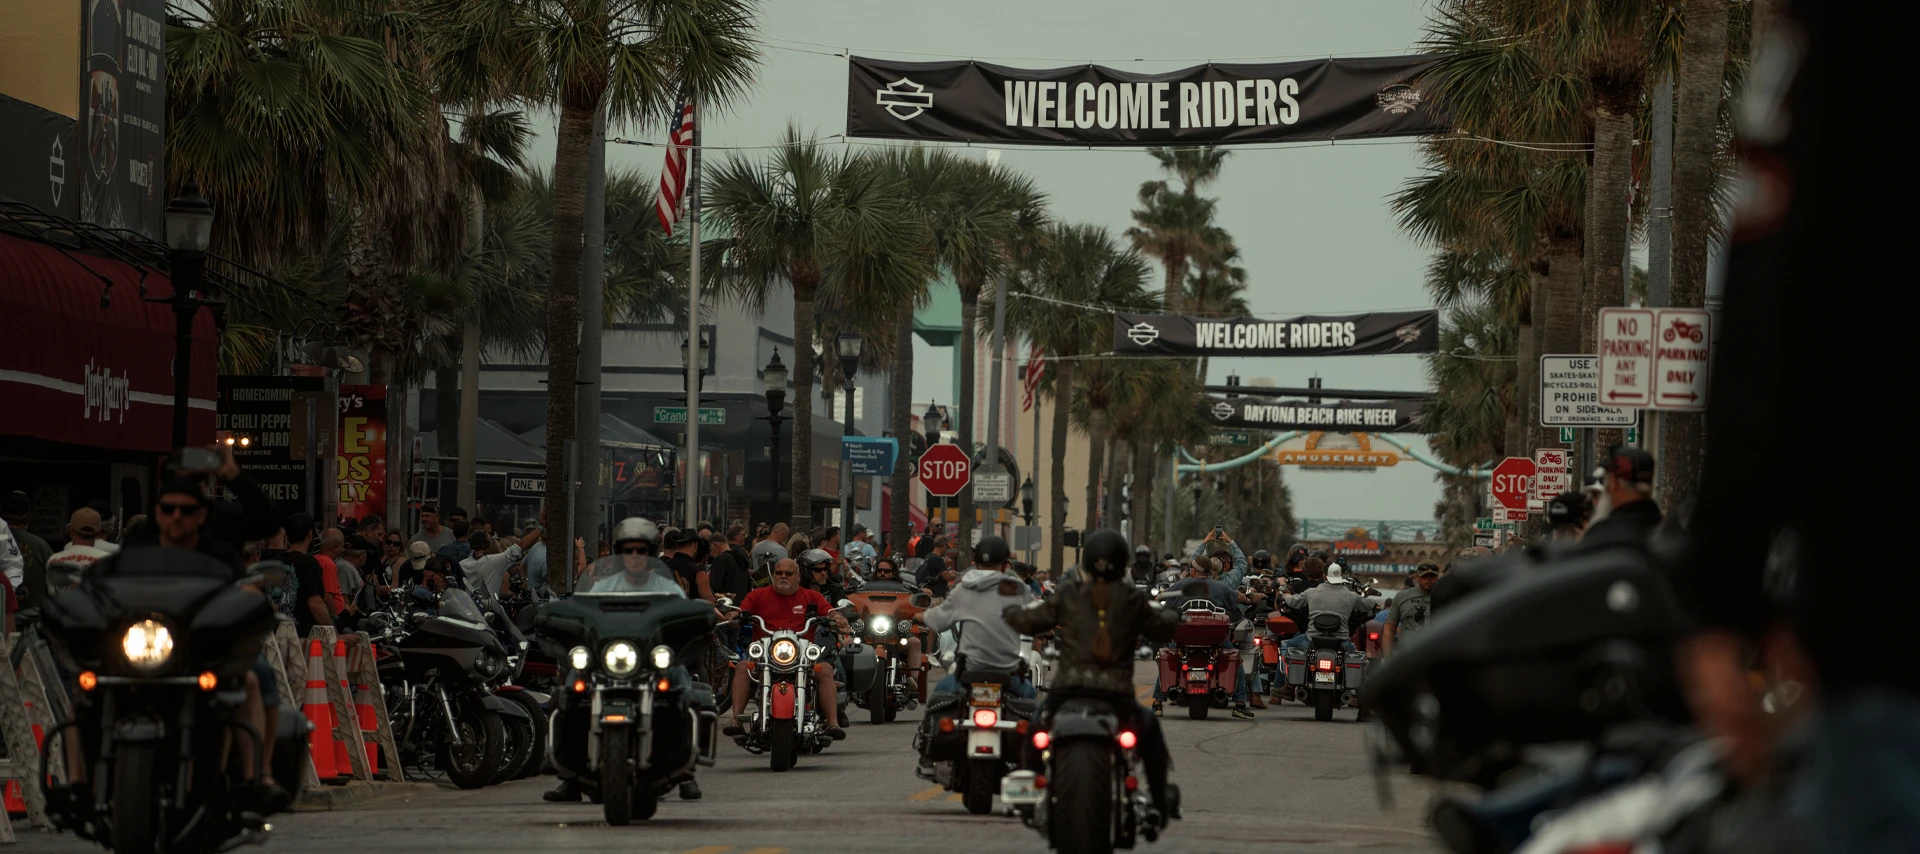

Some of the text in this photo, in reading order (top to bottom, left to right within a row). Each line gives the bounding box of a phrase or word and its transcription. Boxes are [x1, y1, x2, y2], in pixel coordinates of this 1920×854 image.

[1004, 78, 1300, 129] WELCOME RIDERS
[1617, 317, 1638, 337] NO
[1196, 322, 1356, 349] WELCOME RIDERS
[1603, 340, 1650, 358] PARKING
[1658, 348, 1708, 361] PARKING
[1569, 360, 1590, 369] USE
[1615, 361, 1636, 372] ANY
[1614, 373, 1637, 387] TIME
[1666, 370, 1696, 384] ONLY
[84, 357, 129, 424] Dirty Harry's
[1554, 393, 1598, 402] PROHIB
[216, 413, 291, 429] OT CHILI PEPPE
[1244, 404, 1397, 426] DAYTONA BEACH BIKE WEEK
[261, 431, 292, 447] HARD
[1209, 433, 1234, 444] antic
[1564, 428, 1573, 440] N
[1284, 454, 1389, 463] AMUSEMENT
[922, 460, 967, 480] STOP
[514, 479, 533, 490] ONE
[1495, 474, 1535, 493] STO
[42, 489, 59, 499] NO
[260, 483, 299, 500] CKETS
